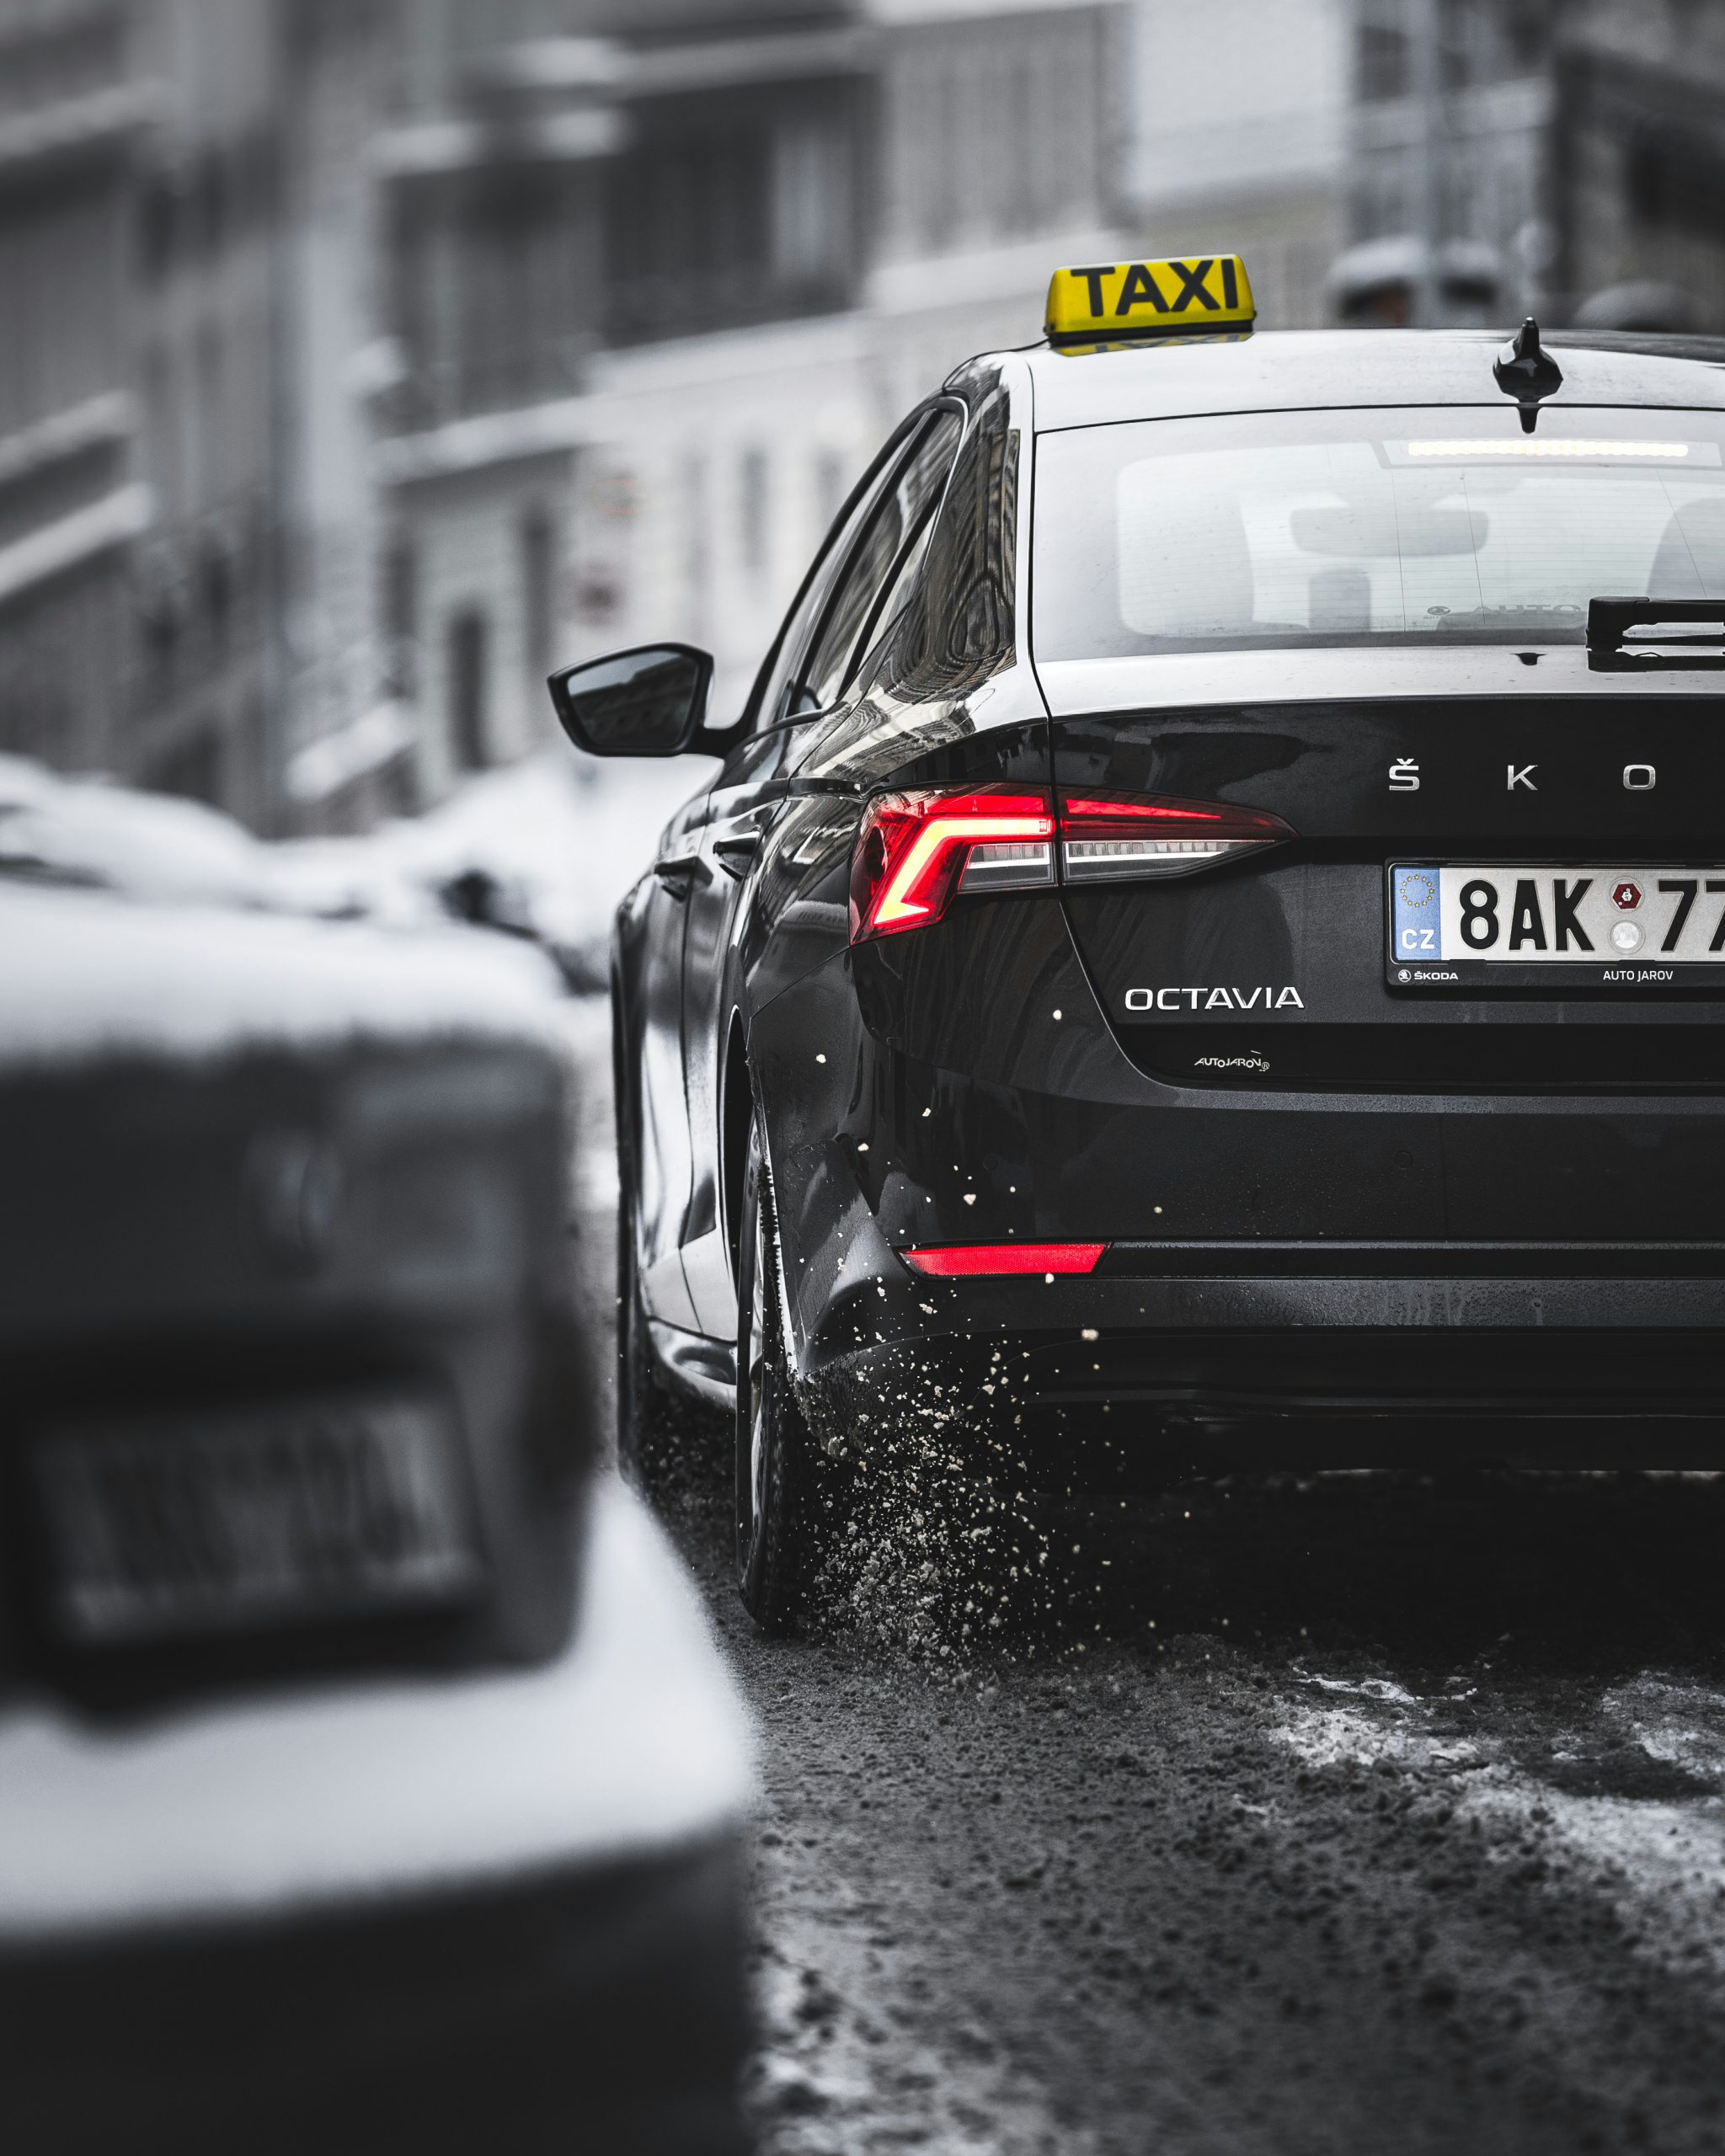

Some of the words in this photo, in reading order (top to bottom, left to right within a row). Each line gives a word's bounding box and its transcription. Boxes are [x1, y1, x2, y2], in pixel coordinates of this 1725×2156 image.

[1071, 258, 1239, 318] TAXI
[1459, 878, 1595, 951] 8AK
[1402, 928, 1434, 950] CZ
[1413, 970, 1459, 980] ŠKODA
[1603, 970, 1635, 980] AUTO
[1637, 970, 1674, 983] JAROV
[1124, 986, 1305, 1011] OCTAVIA
